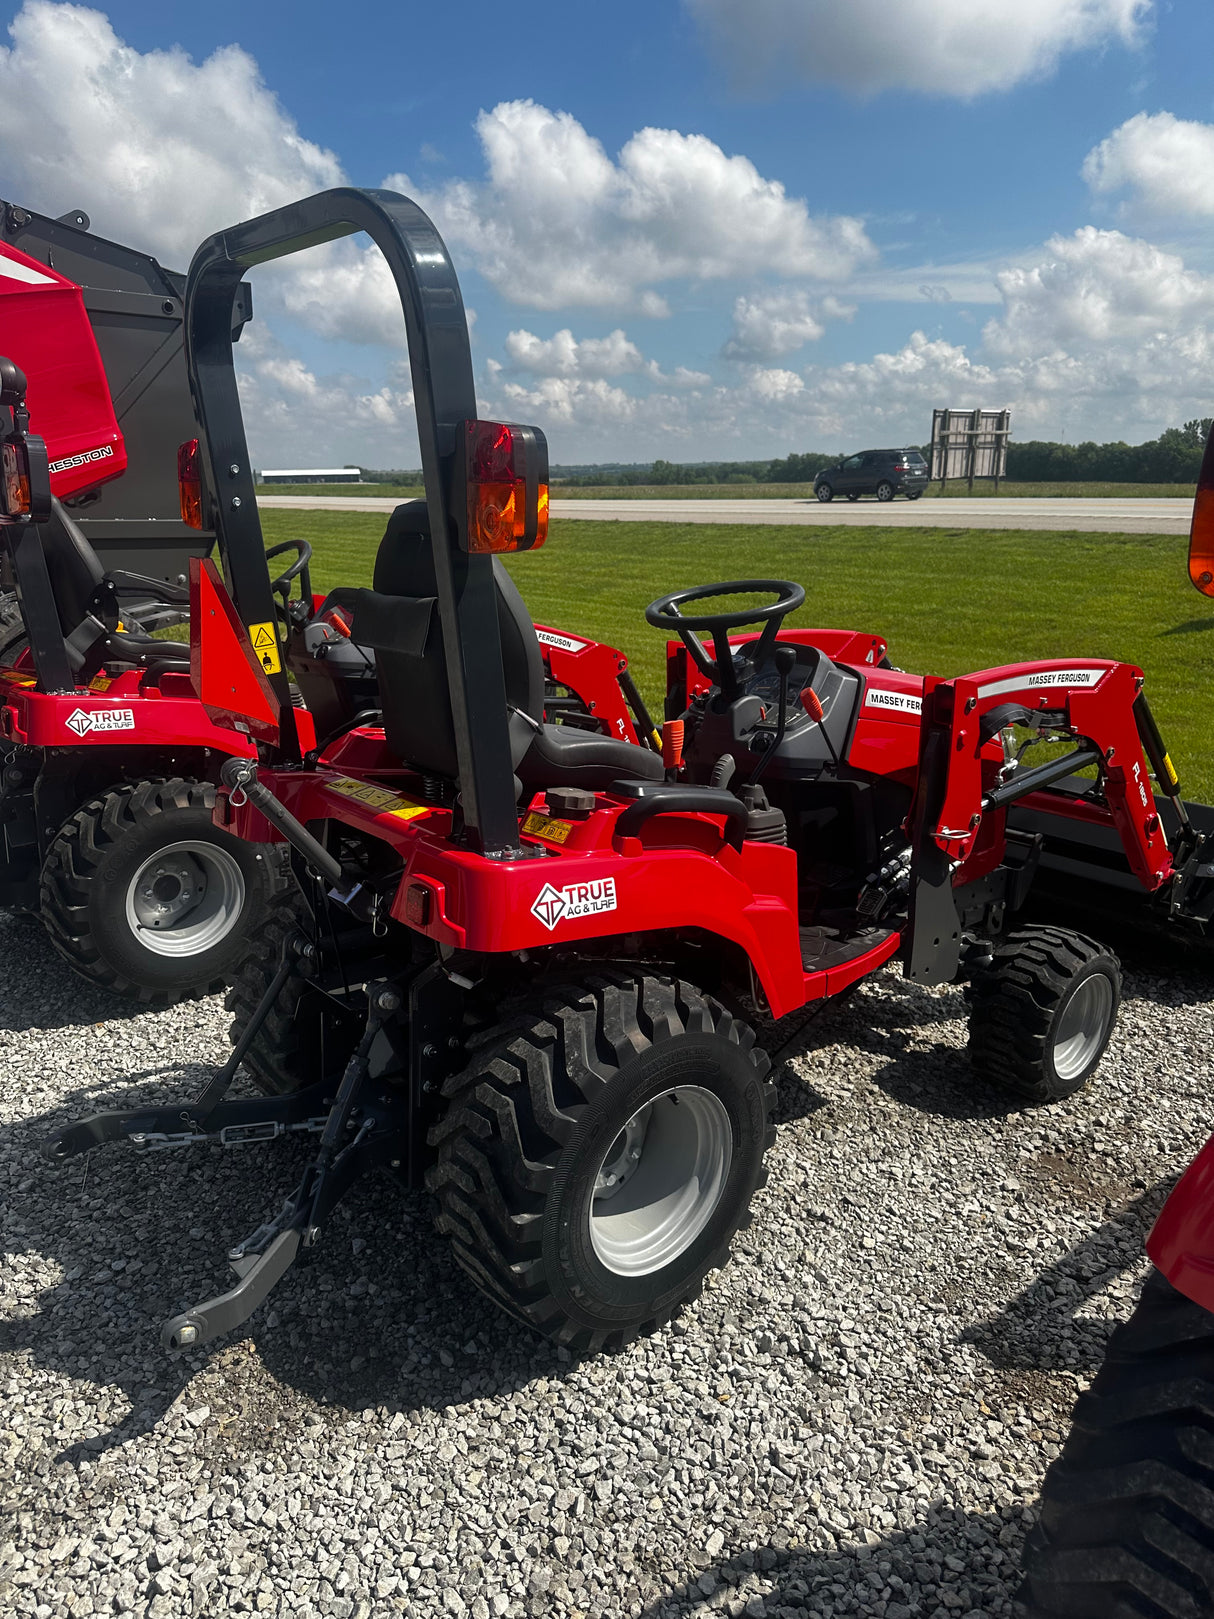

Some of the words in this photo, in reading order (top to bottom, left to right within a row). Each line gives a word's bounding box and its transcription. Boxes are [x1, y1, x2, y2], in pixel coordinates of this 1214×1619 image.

[538, 632, 572, 648] FERGUSON
[1028, 674, 1056, 686] MASSEY
[1057, 673, 1091, 683] FERGUSON
[871, 693, 904, 707] MASSEY
[906, 699, 921, 711] FER
[92, 711, 132, 722] TRUE
[616, 718, 625, 735] FL
[1132, 761, 1141, 783] FL
[565, 880, 614, 904] TRUE
[567, 905, 582, 916] AG
[583, 903, 590, 913] &
[590, 898, 615, 911] TURF
